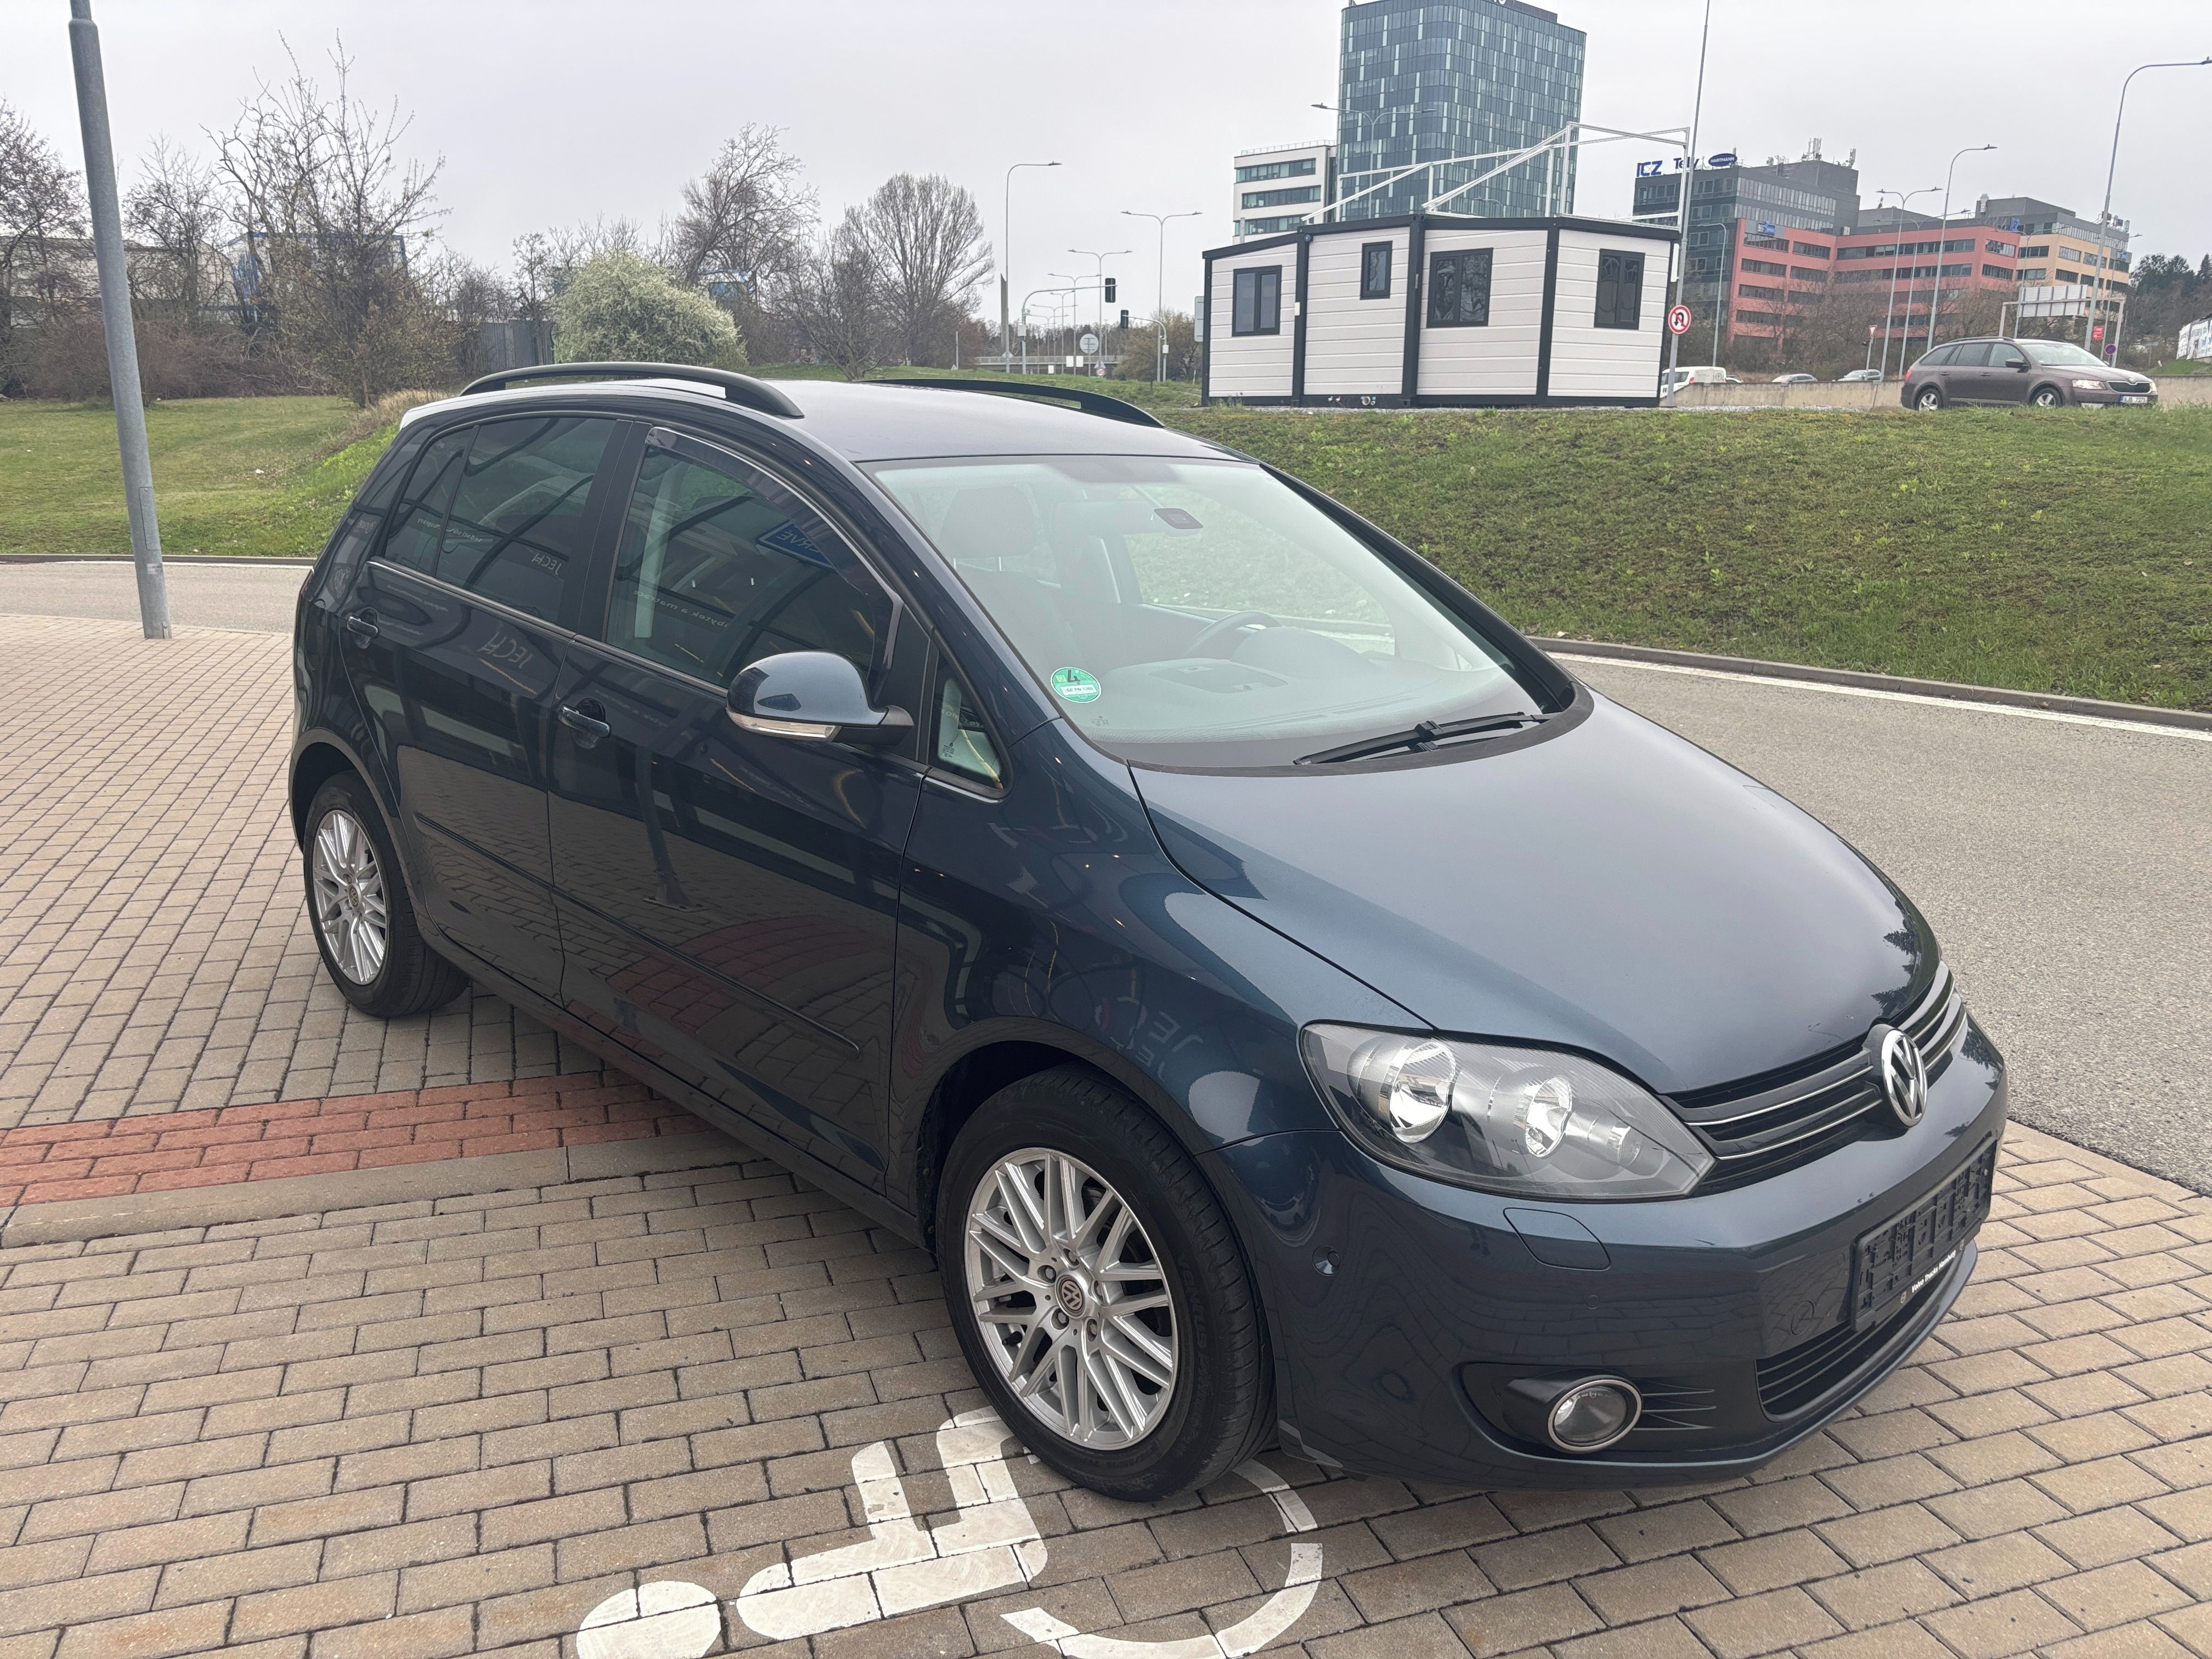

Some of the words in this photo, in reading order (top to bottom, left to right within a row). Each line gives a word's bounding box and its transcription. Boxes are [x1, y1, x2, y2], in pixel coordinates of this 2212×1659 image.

[1637, 160, 1663, 177] ICZ
[1067, 669, 1081, 685] 4
[1938, 1249, 1956, 1271] Hamburg
